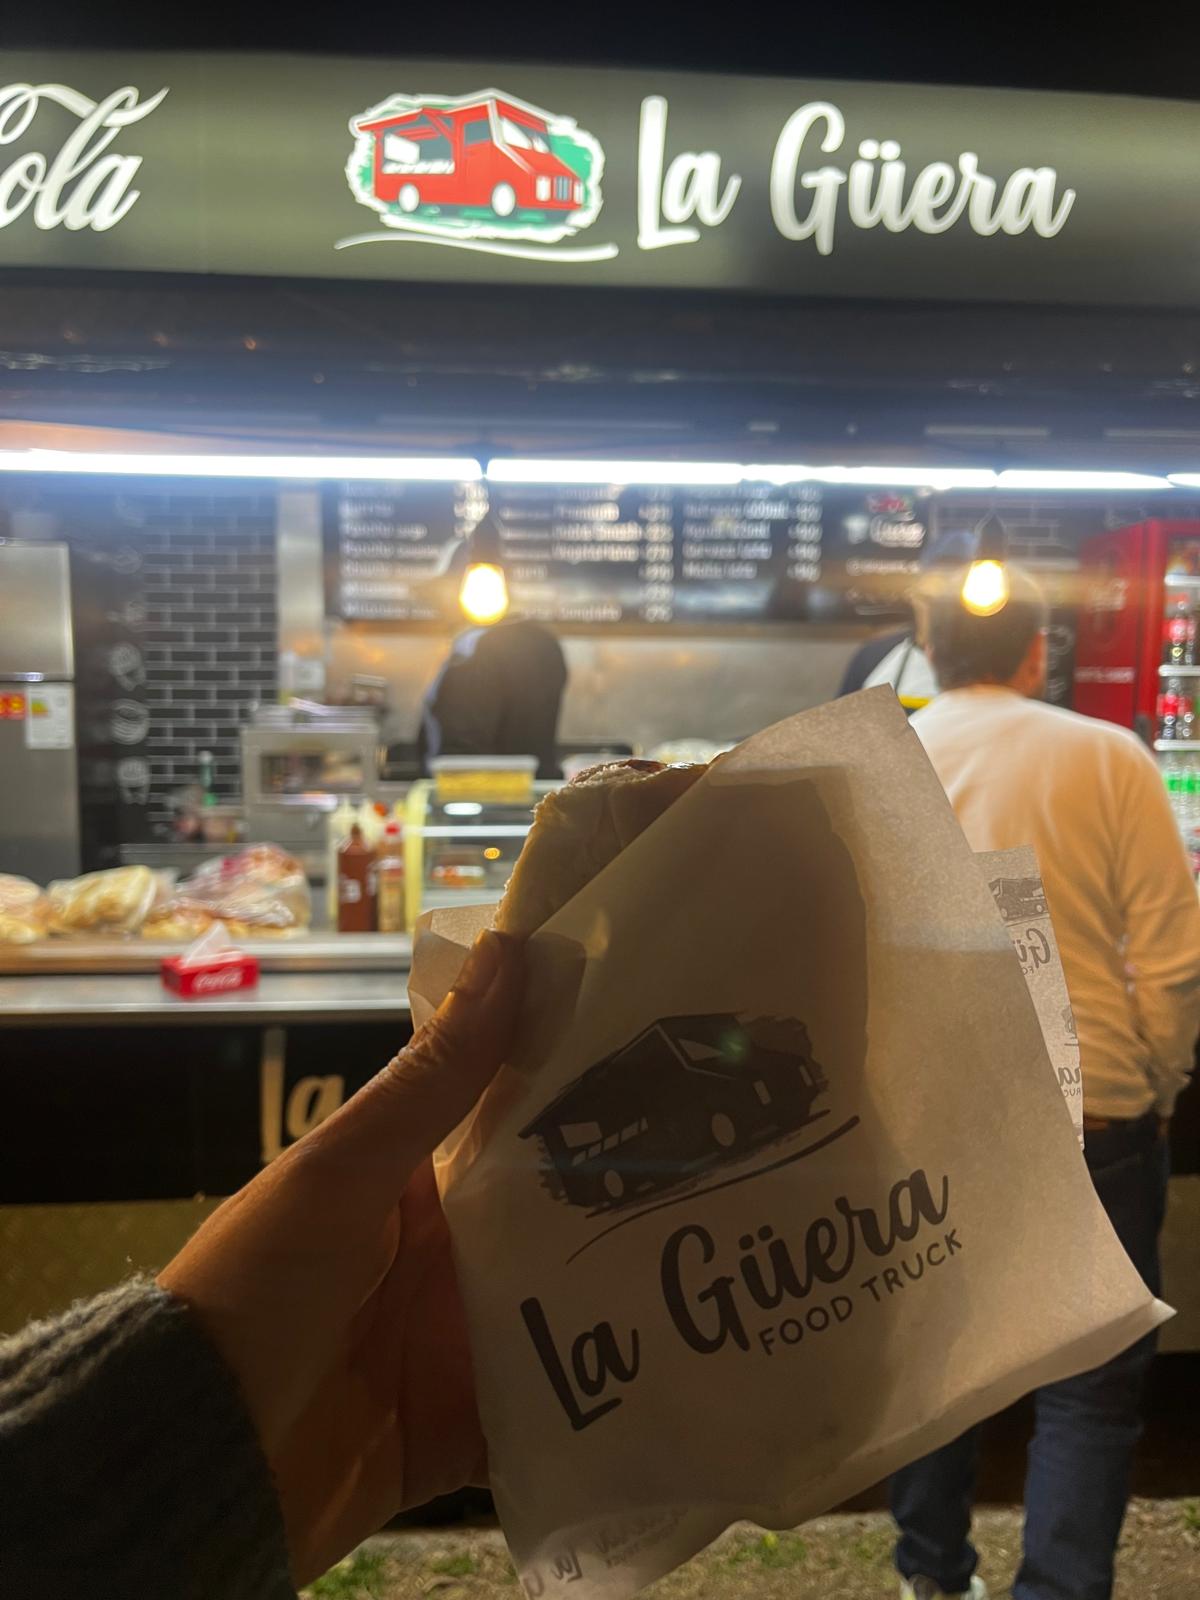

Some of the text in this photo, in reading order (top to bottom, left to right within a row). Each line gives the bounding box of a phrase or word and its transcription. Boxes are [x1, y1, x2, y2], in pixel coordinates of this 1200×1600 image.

[637, 95, 1076, 256] La Güera
[520, 1168, 949, 1431] La Güera
[758, 1228, 963, 1356] FOOD TRUCK
